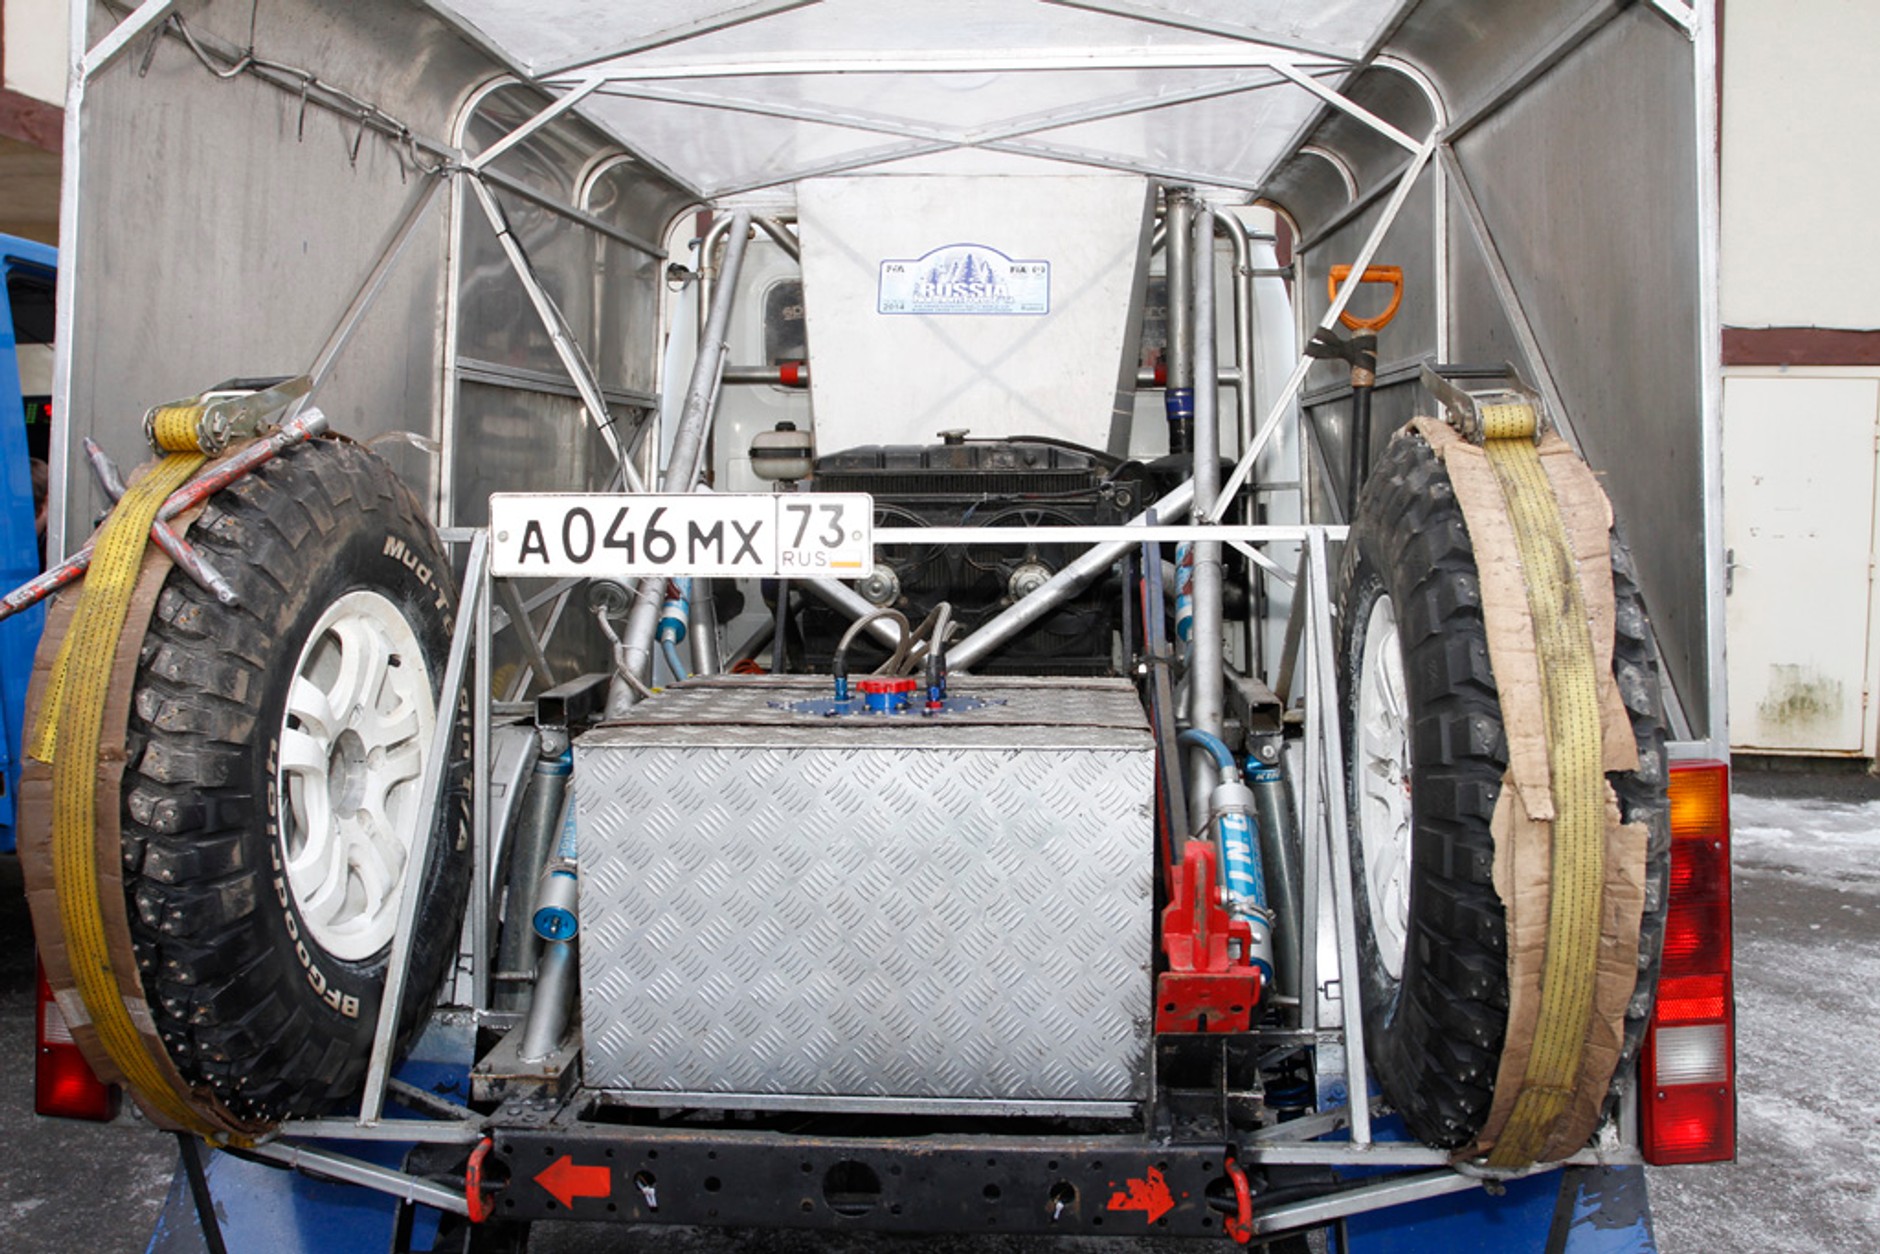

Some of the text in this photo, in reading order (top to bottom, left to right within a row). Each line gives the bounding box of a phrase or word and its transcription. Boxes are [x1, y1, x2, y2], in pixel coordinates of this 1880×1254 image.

[923, 281, 1008, 298] RUSSIA
[786, 503, 845, 549] 73
[782, 551, 827, 567] RUS
